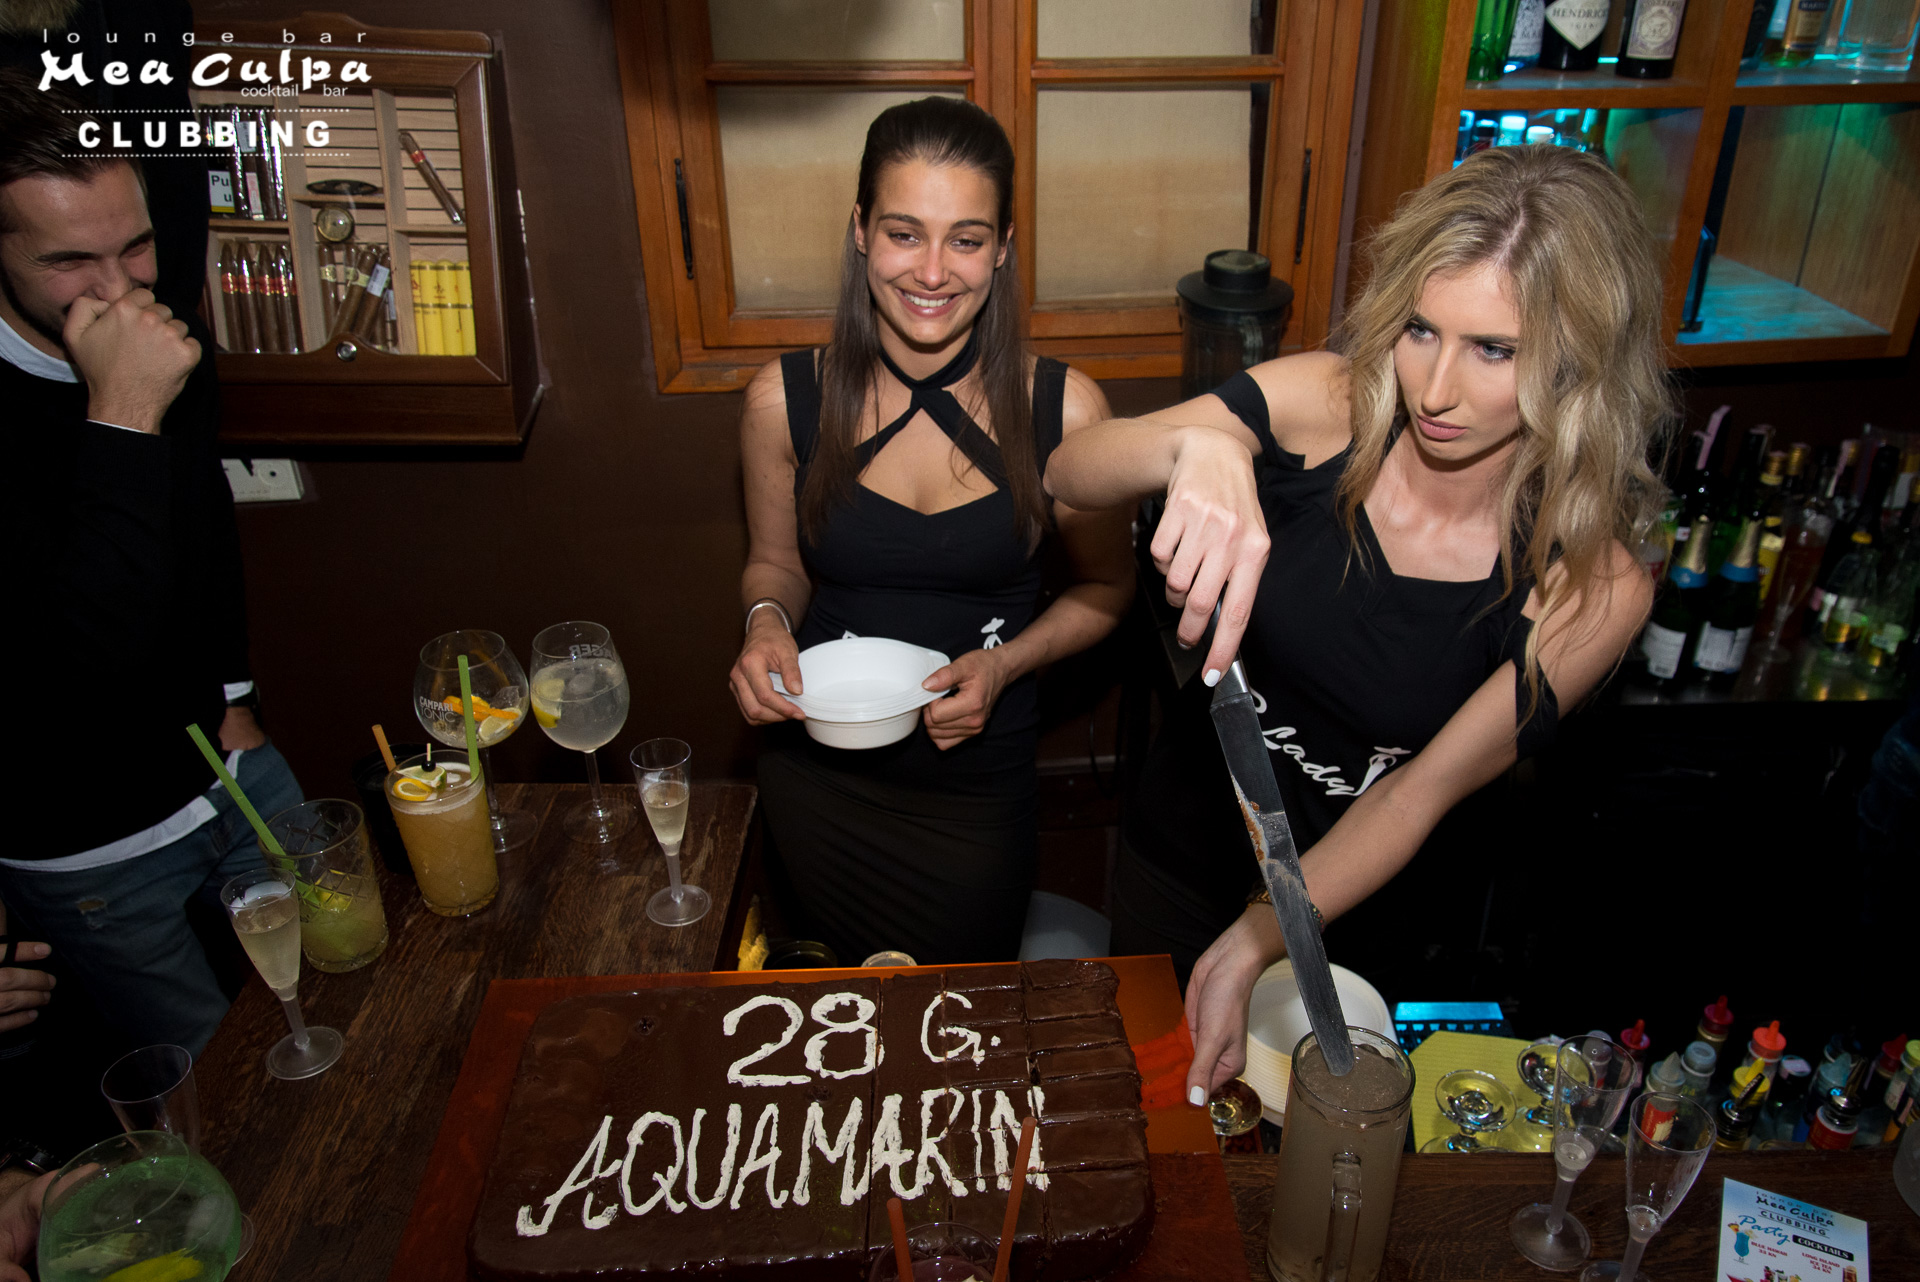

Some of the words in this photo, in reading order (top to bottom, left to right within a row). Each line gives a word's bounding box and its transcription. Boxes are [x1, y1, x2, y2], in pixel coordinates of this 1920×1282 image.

[419, 695, 454, 712] CAMPARI
[420, 704, 457, 723] TONIC
[722, 992, 884, 1087] 28
[1756, 1196, 1787, 1211] Mea
[1789, 1207, 1834, 1226] Culpa
[1760, 1210, 1827, 1236] CLUBBING
[1738, 1215, 1791, 1245] Party
[1797, 1236, 1850, 1259] COCKTAILS
